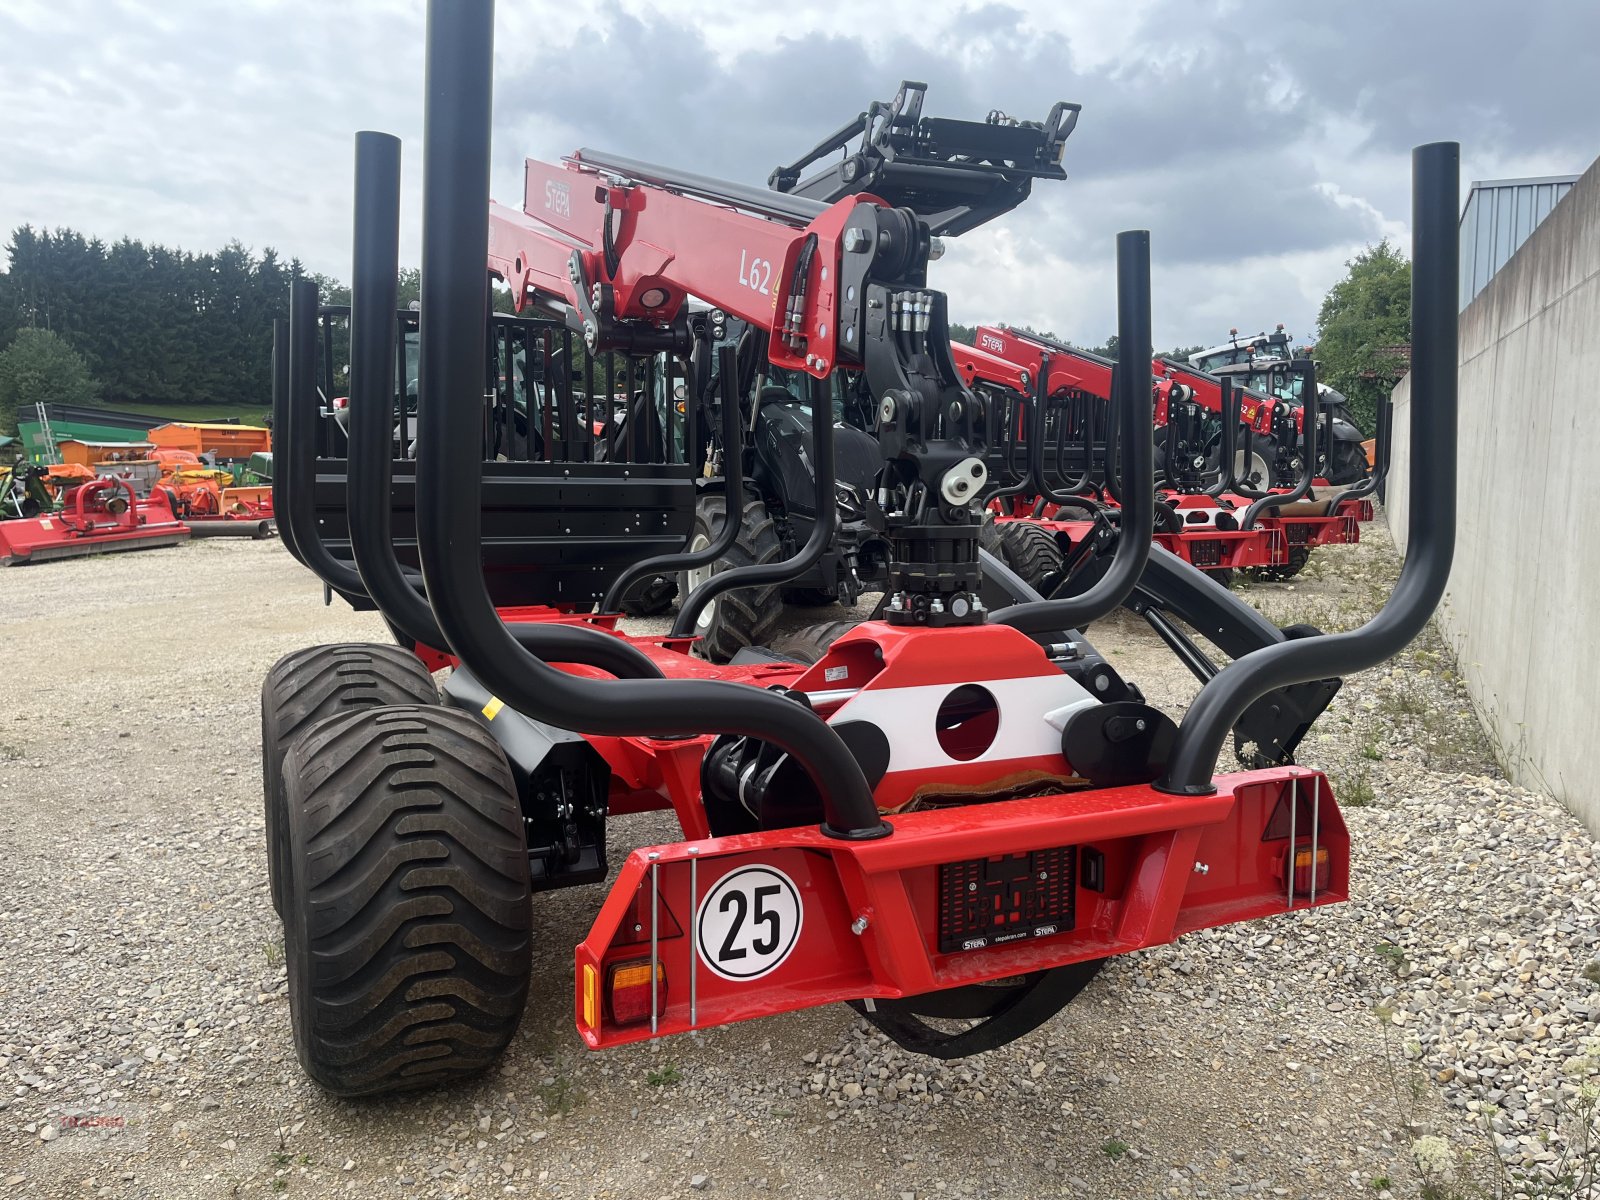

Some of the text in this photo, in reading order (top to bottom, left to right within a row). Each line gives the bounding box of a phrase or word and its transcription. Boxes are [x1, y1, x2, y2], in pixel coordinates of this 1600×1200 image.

[545, 179, 570, 217] STEPA
[739, 249, 771, 295] L62
[981, 334, 1003, 353] STEPA
[718, 884, 781, 962] 25
[964, 926, 1055, 950] STEPA stepakran.com STEPA
